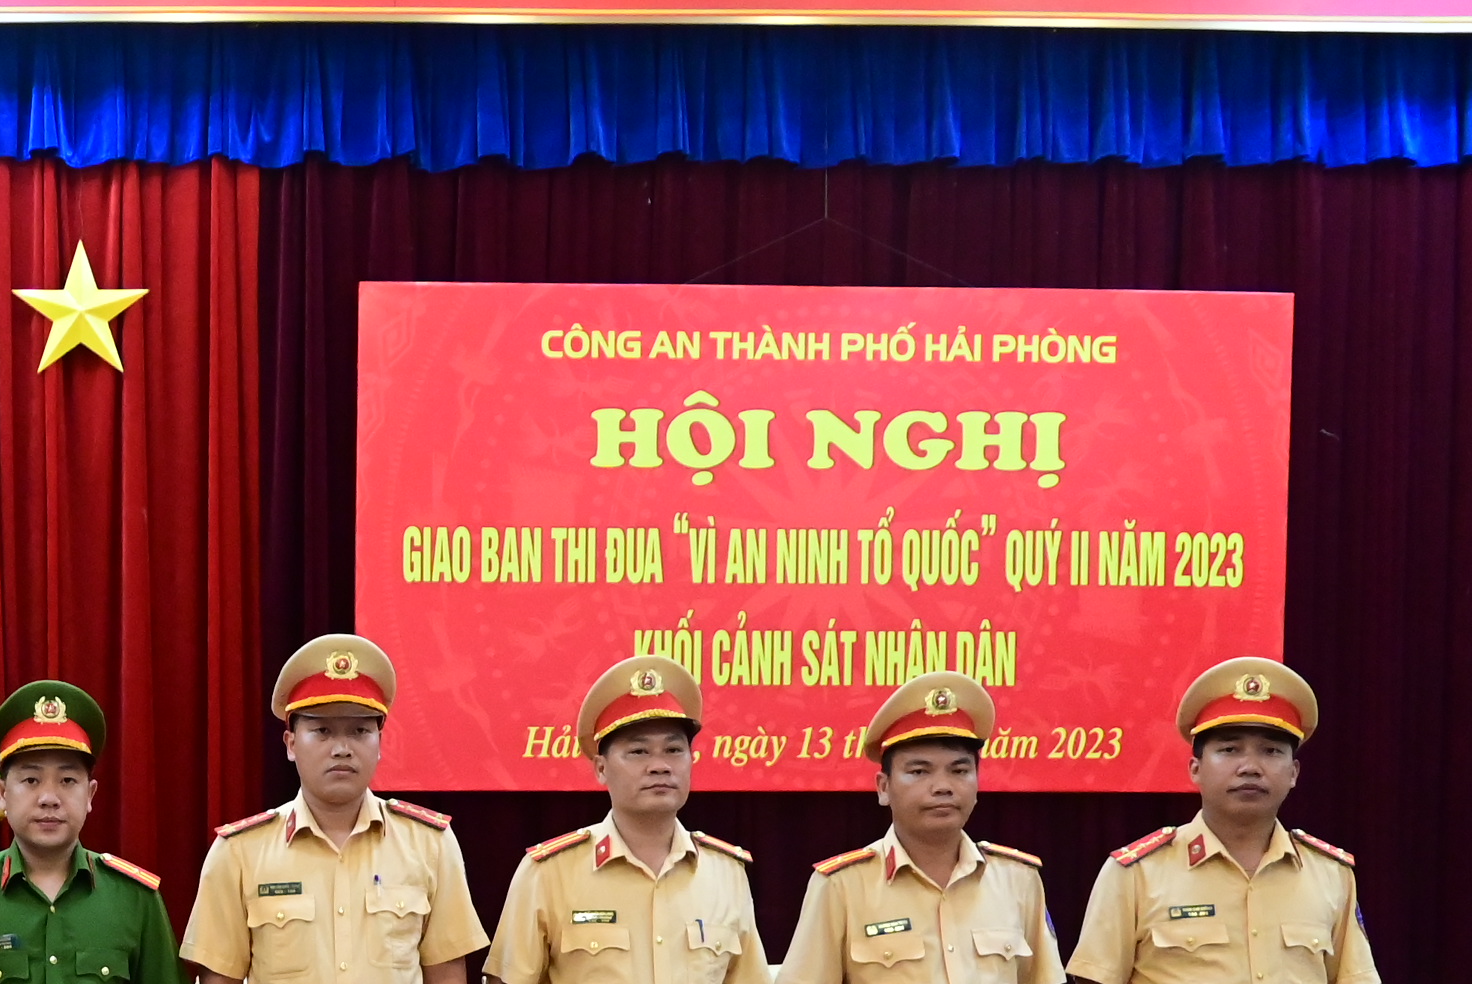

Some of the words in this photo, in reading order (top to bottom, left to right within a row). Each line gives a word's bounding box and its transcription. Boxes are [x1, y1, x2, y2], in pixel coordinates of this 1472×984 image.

[541, 323, 642, 360] CÔNG
[648, 330, 701, 360] AN
[708, 325, 831, 361] THÀNH
[840, 322, 917, 363] PHỐ
[924, 326, 983, 363] HẢI
[992, 328, 1118, 364] PHÒNG
[590, 389, 776, 486] HỘI
[805, 409, 1067, 489] NGHỊ
[402, 525, 472, 583] GIAO
[480, 526, 542, 583] BAN
[550, 527, 597, 583] THI
[605, 527, 664, 584] ĐUA
[724, 528, 767, 584] AN
[775, 528, 849, 585] NINH
[856, 506, 895, 585] TỔ
[1005, 518, 1063, 592] QUÝ
[1070, 530, 1090, 586] II
[1098, 519, 1166, 587] NĂM
[1173, 532, 1244, 588] 2023
[711, 610, 793, 686] CẢNH
[801, 618, 857, 686] SÁT
[865, 618, 947, 685] NHÂN
[956, 619, 1017, 686] DÂN
[712, 726, 787, 767] ngày
[797, 726, 834, 759] 13
[1047, 726, 1124, 760] 2023
